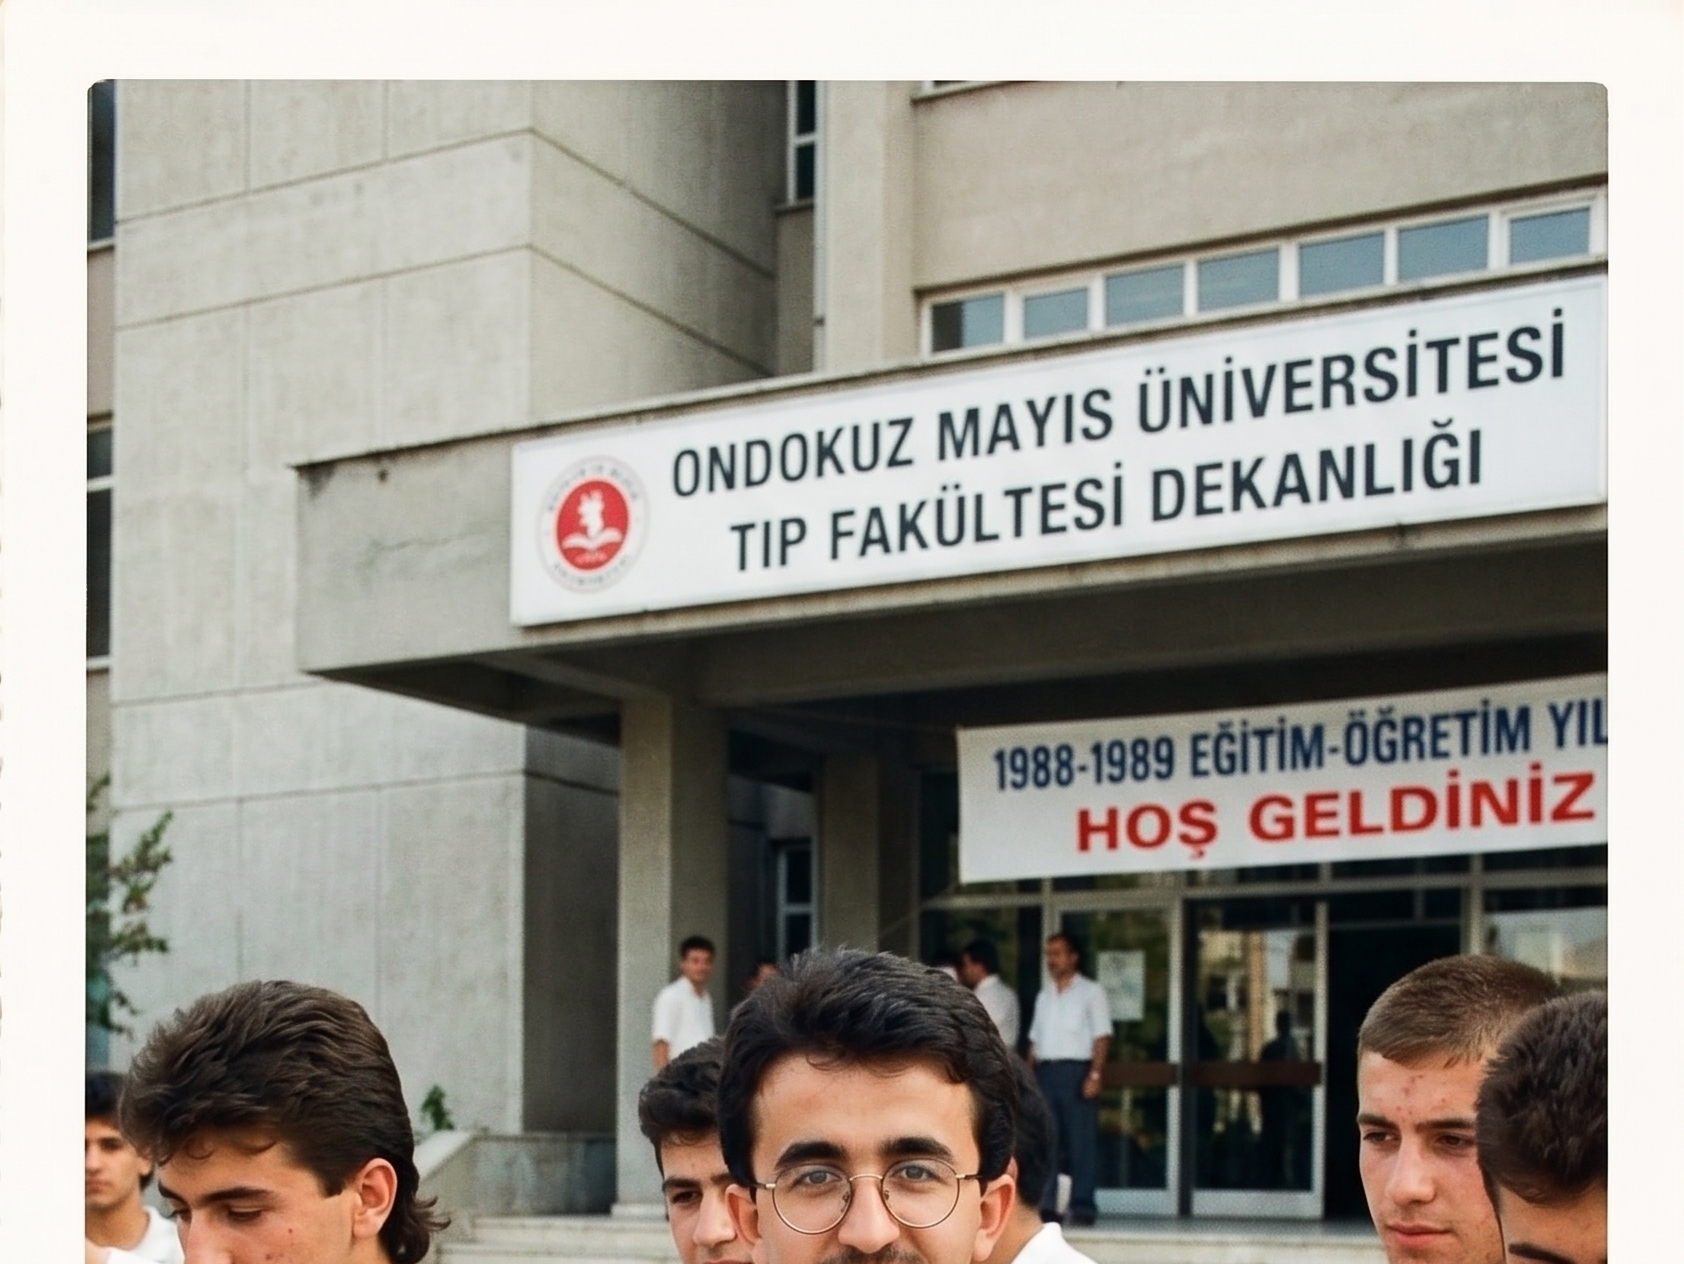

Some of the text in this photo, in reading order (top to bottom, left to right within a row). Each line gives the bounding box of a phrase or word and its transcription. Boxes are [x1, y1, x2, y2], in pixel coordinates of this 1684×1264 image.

[672, 417, 914, 498] ONDOKUZ
[937, 388, 1113, 461] MAYIS
[1138, 307, 1565, 434] ÜNİVERSİTESİ
[730, 417, 1482, 572] TIP FAKÜLTESİ DEKANLIĞI
[994, 698, 1608, 791] 1988-1989 EĞİTİM-ÖĞRETİM YIL
[1076, 761, 1596, 859] HOŞ GELDİNİZ
